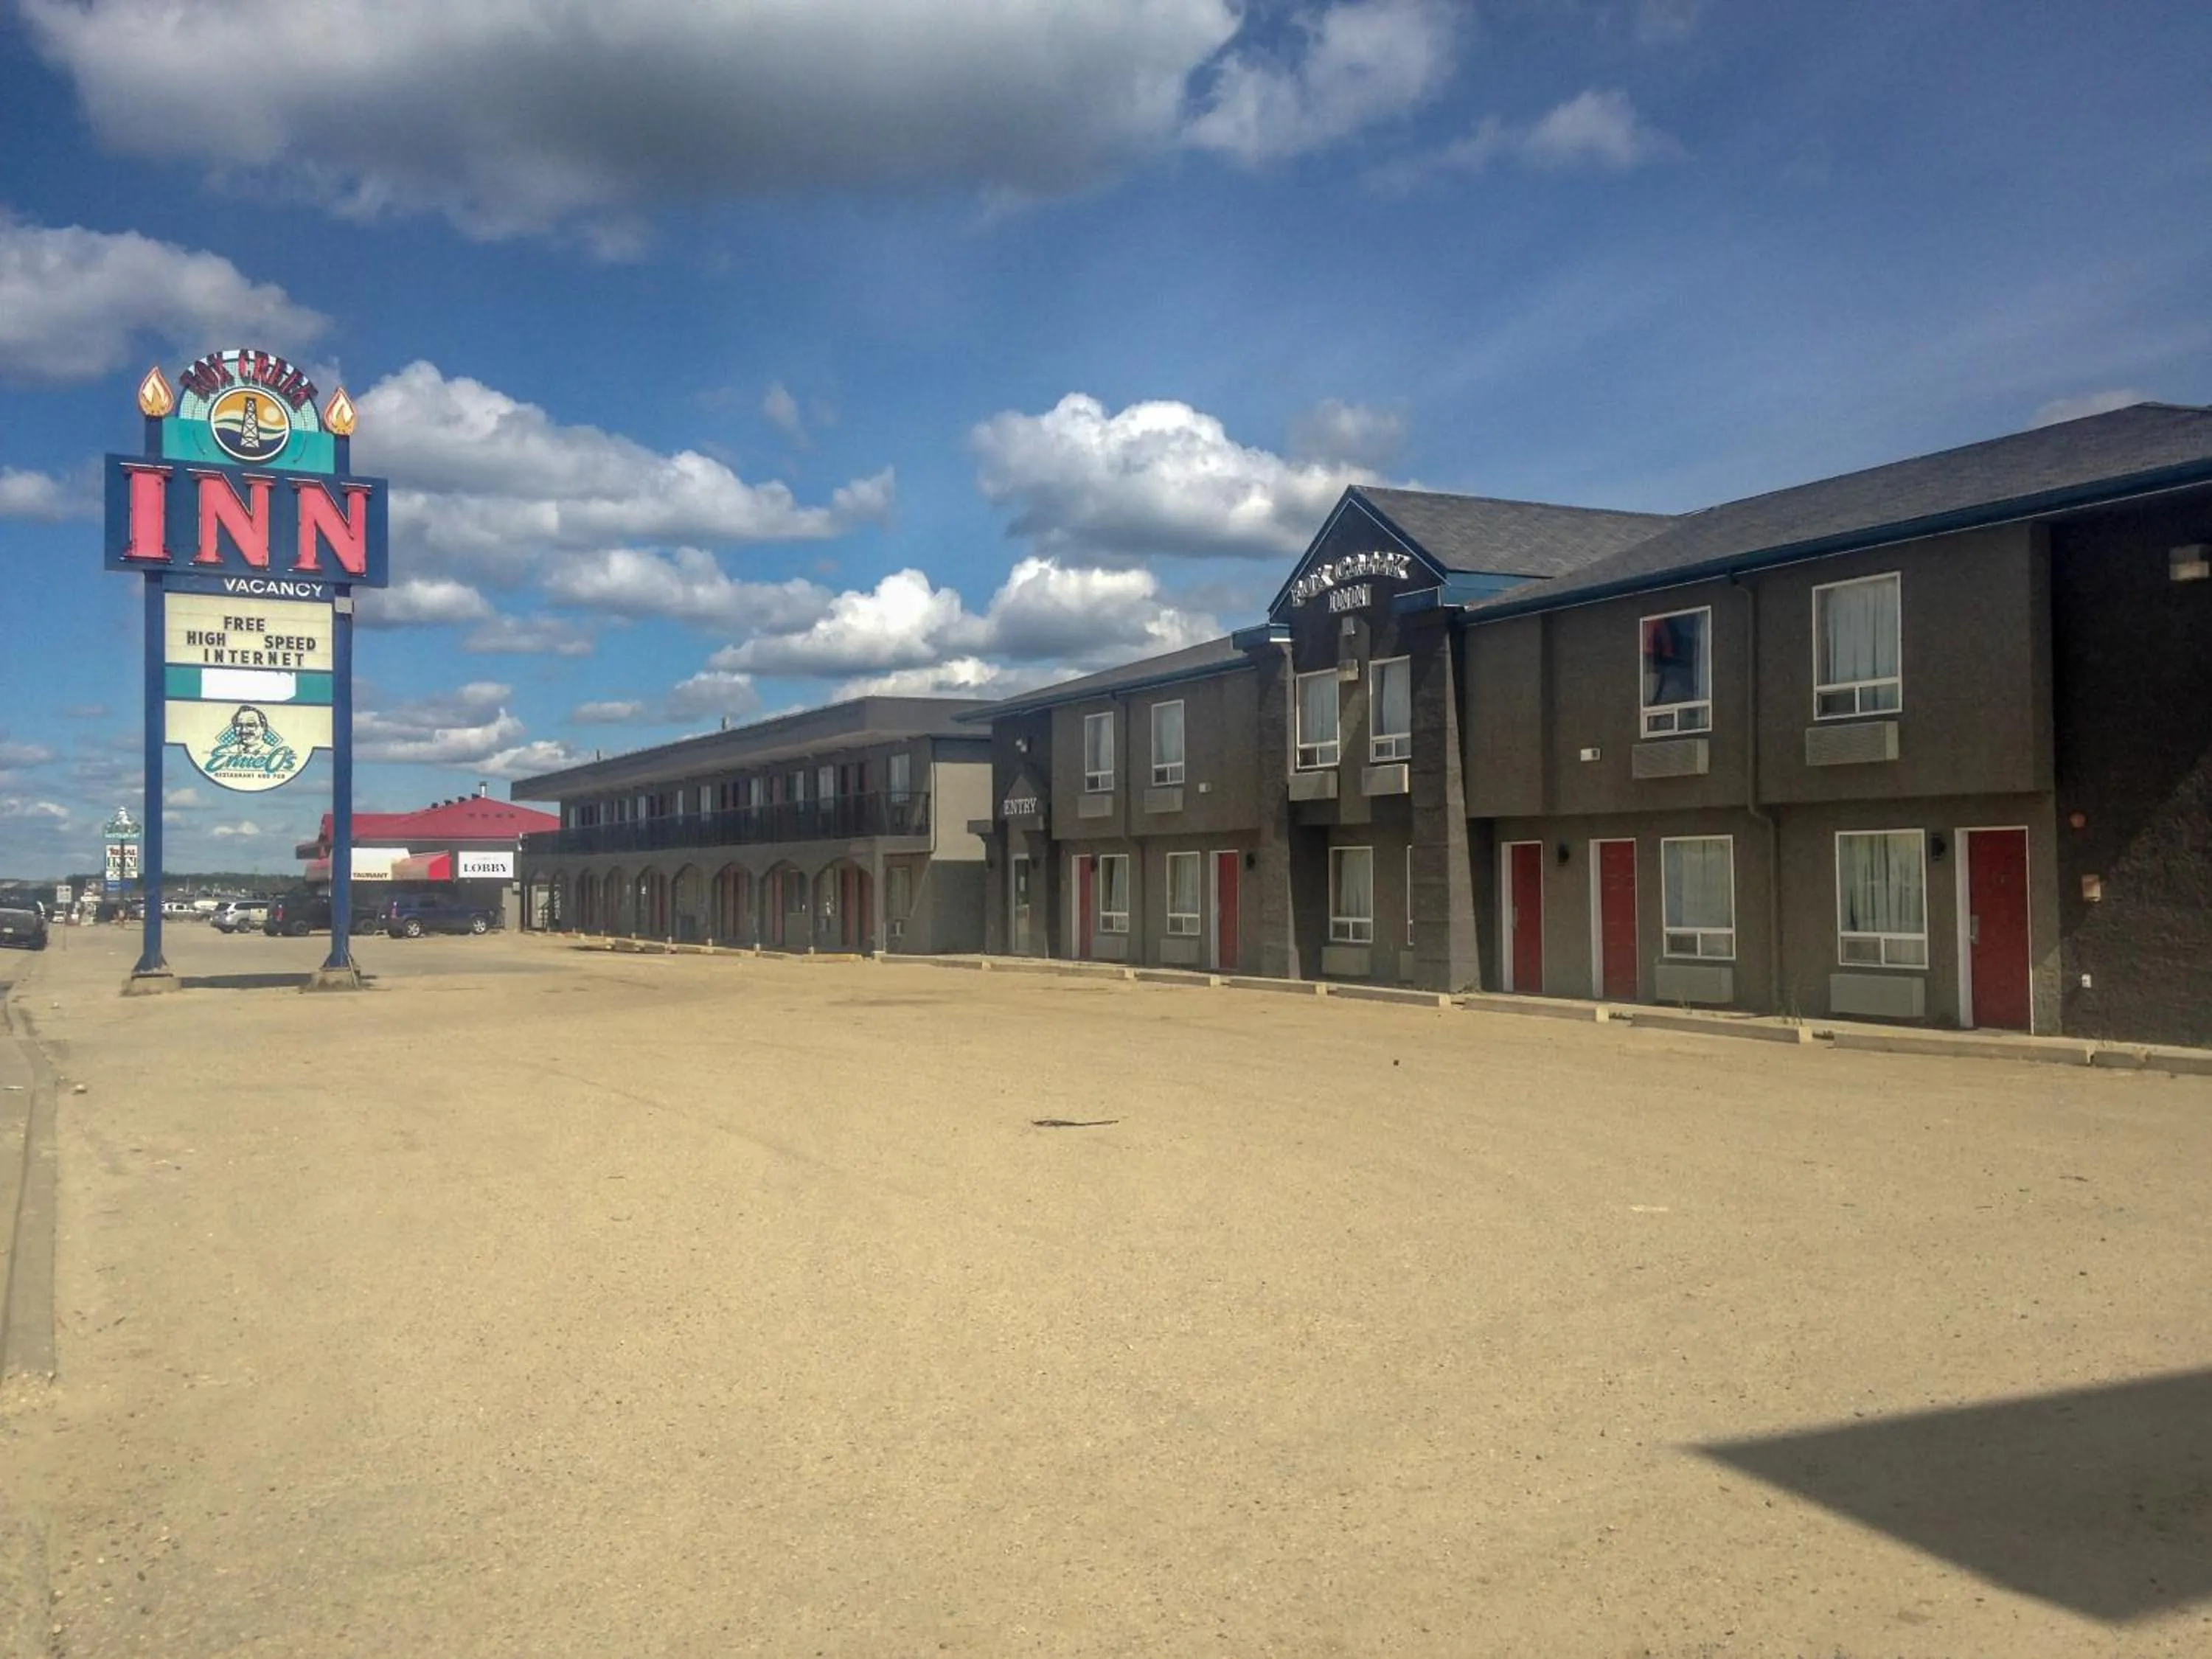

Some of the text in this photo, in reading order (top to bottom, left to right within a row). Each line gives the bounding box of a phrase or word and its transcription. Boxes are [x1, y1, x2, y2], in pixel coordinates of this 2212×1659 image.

[239, 349, 319, 413] CREEK
[119, 462, 372, 577] INN
[224, 578, 323, 597] VACANCY
[223, 616, 265, 632] FREE
[187, 630, 316, 650] HIGH SPEED
[204, 648, 305, 667] INTERNET
[1004, 797, 1037, 815] ENTRY
[464, 863, 508, 872] LOBBY
